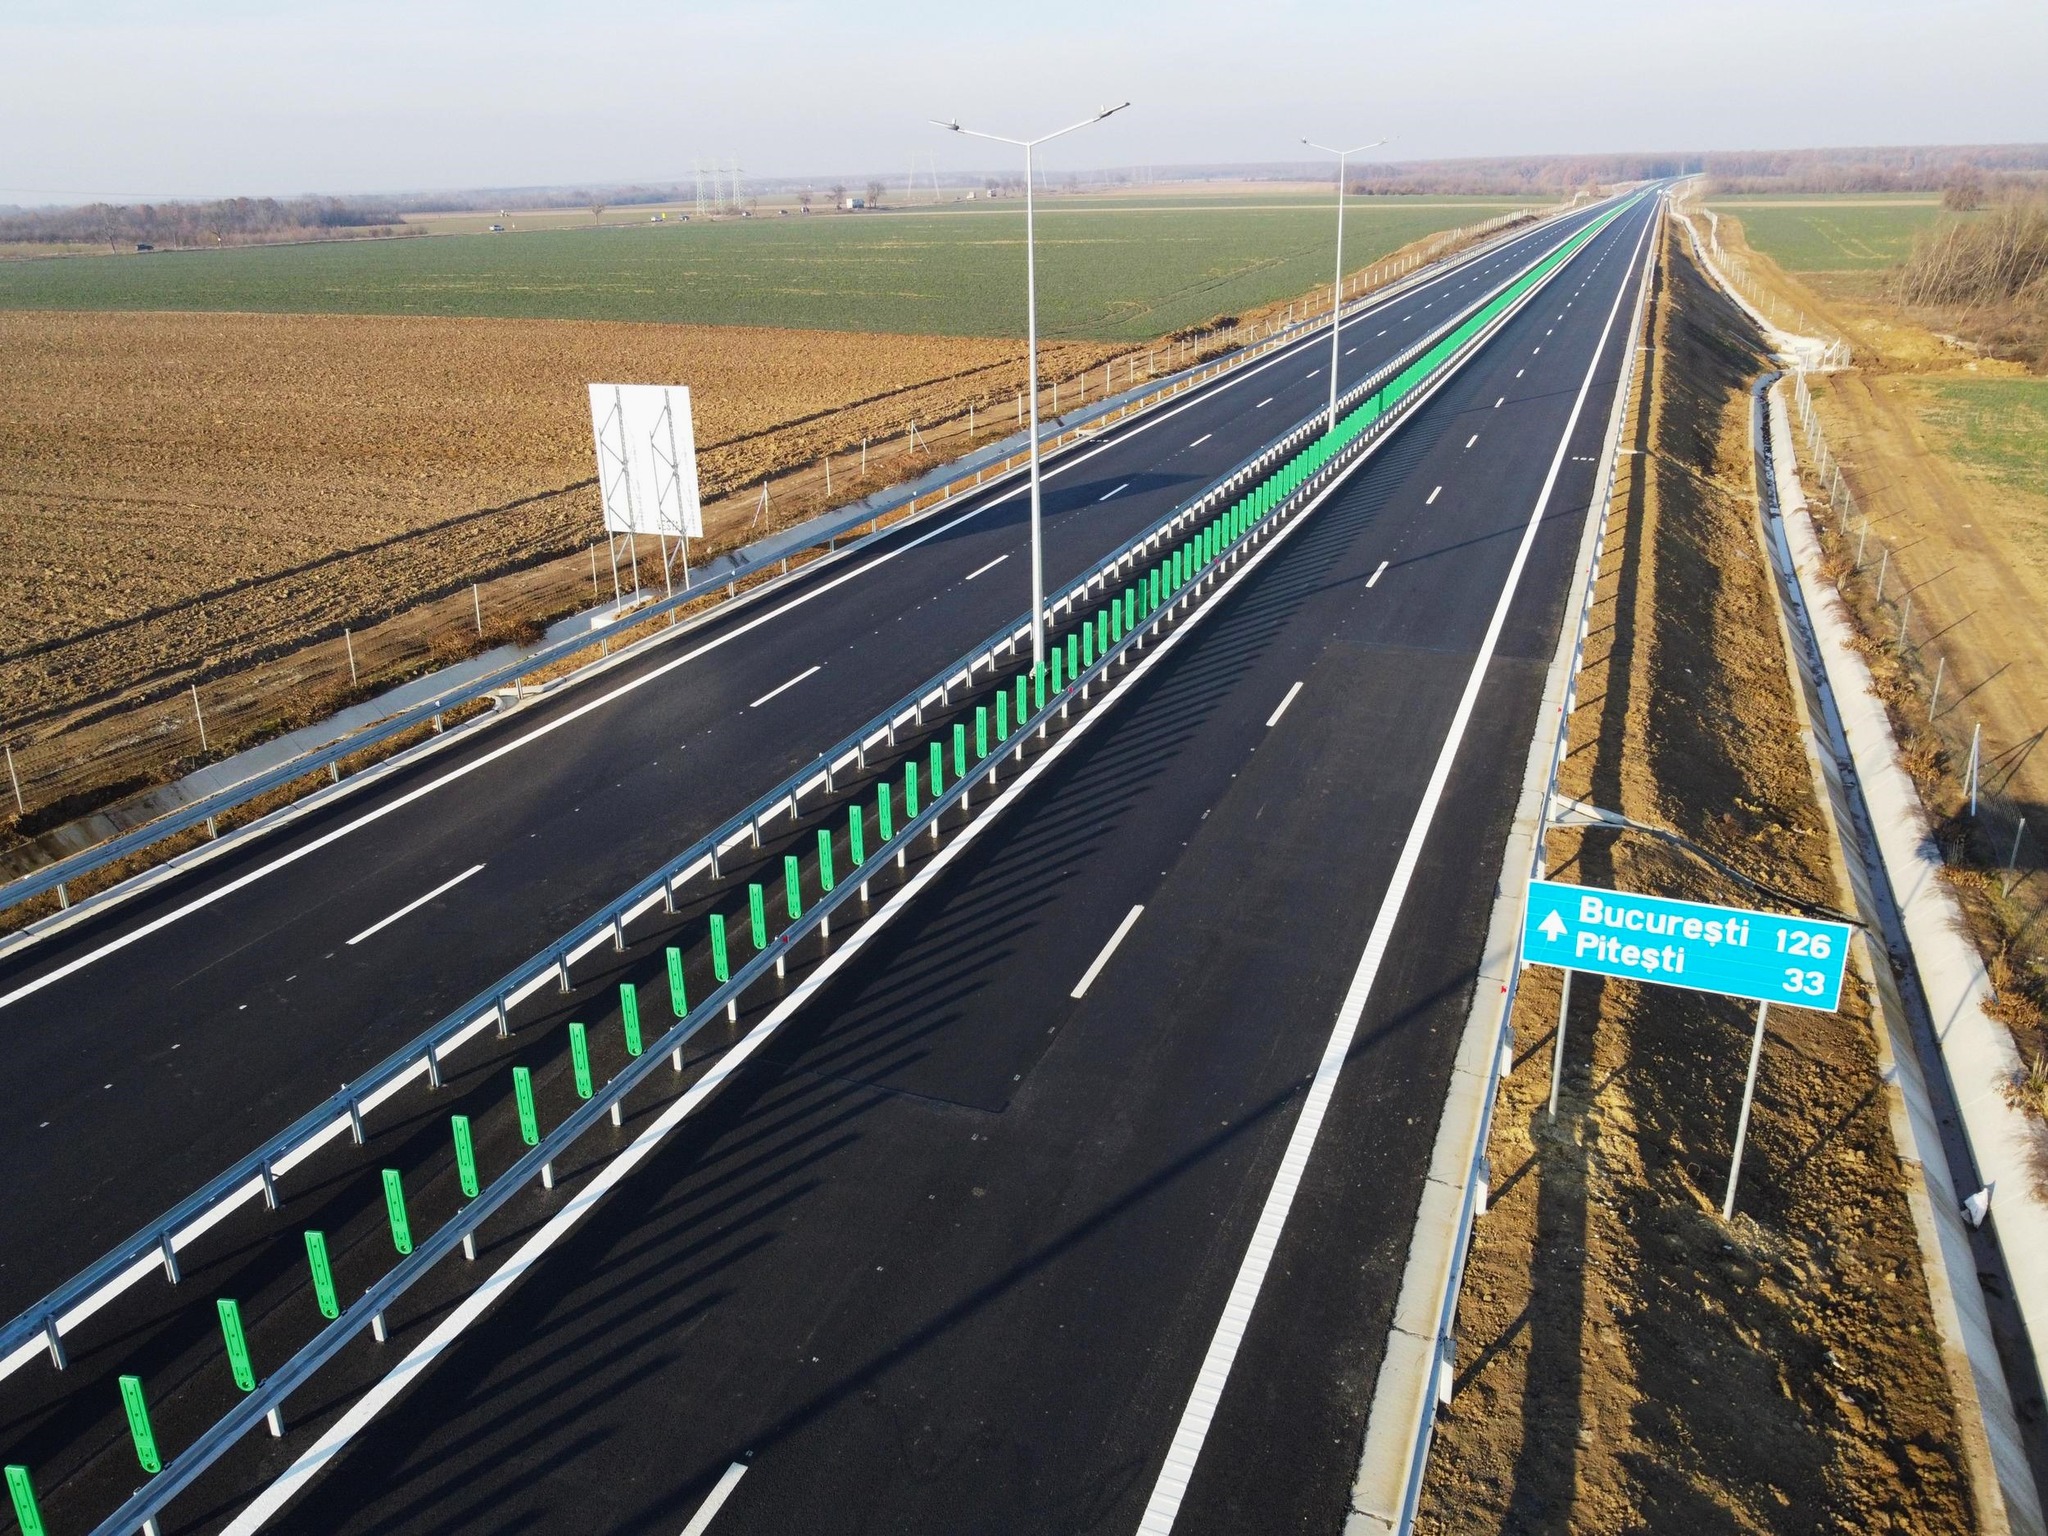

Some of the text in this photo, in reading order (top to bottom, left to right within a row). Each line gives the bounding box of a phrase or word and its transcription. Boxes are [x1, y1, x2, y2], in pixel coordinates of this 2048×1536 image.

[1579, 895, 1832, 960] București 126
[1575, 931, 1826, 996] Pitești 33
